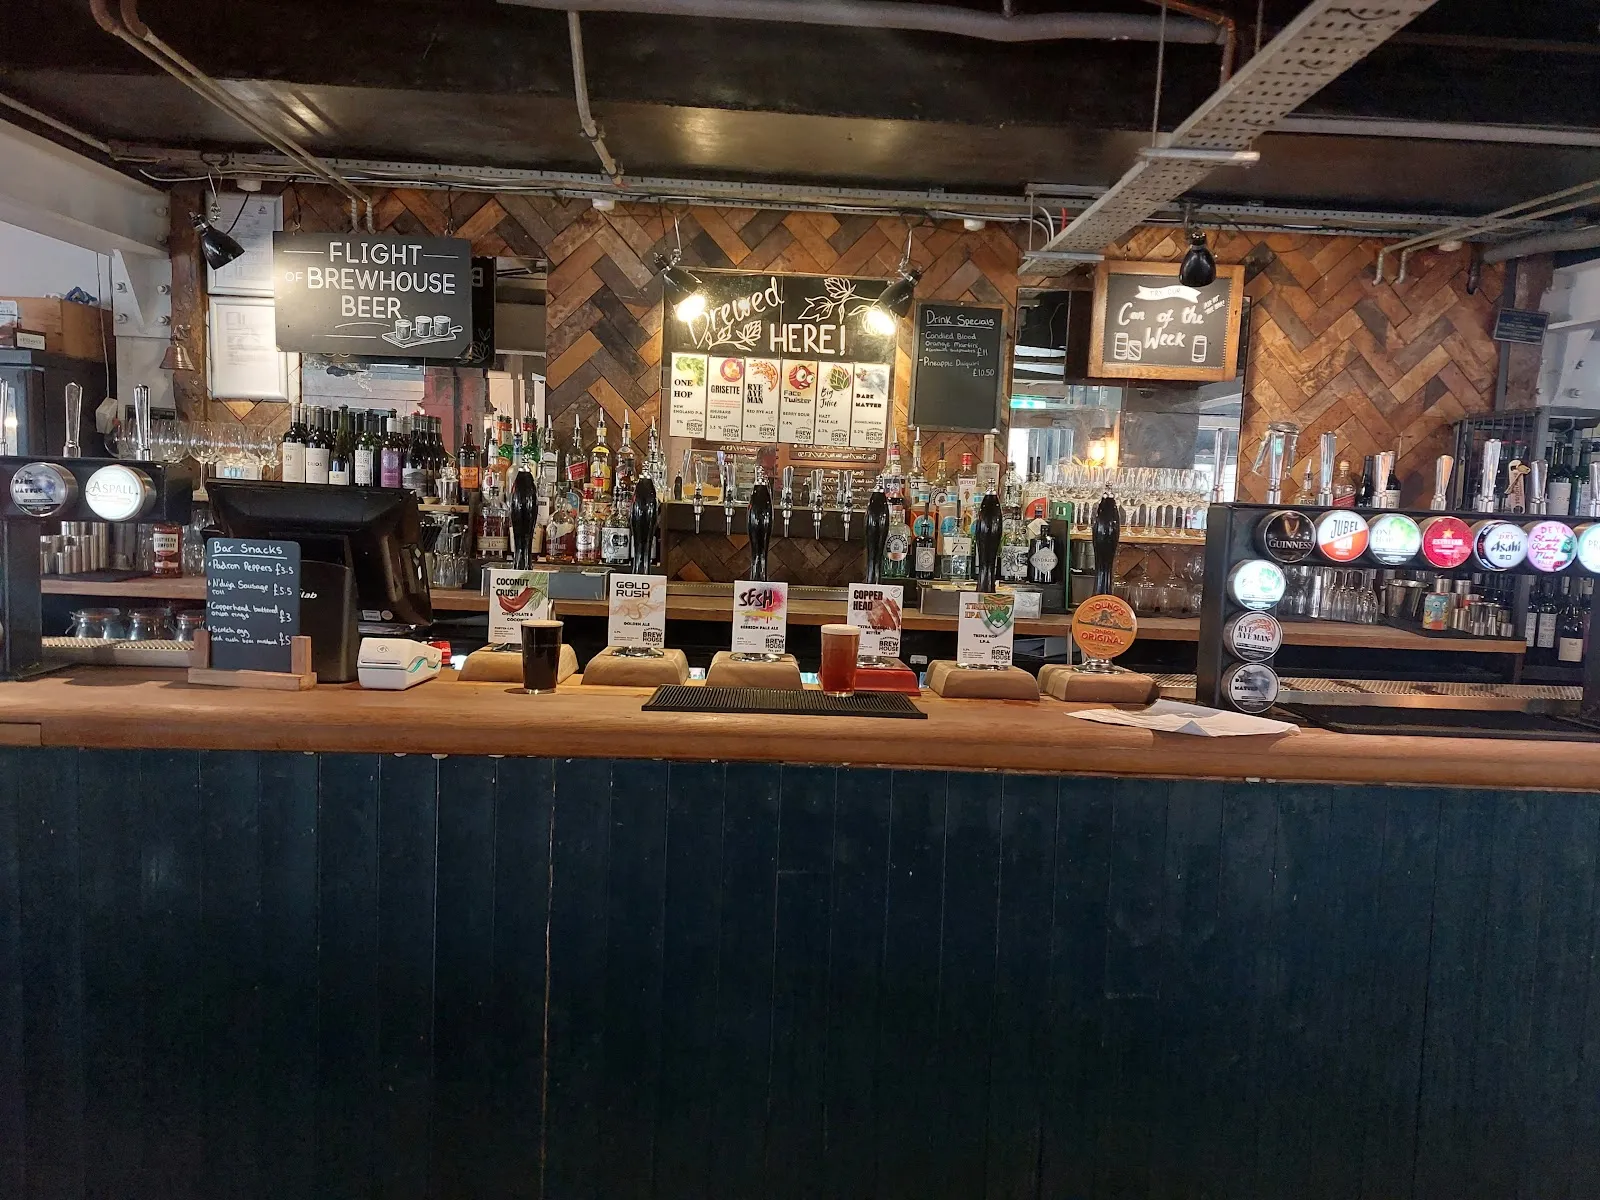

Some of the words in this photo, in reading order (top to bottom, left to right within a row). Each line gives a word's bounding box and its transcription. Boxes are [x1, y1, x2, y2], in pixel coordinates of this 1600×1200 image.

[329, 242, 422, 265] FLIGHT
[285, 271, 303, 282] OF
[307, 266, 456, 295] BREWHOUSE
[341, 295, 402, 319] BEER
[926, 310, 952, 325] Drink
[957, 314, 995, 327] Specials
[1118, 302, 1145, 326] Can
[1156, 308, 1174, 328] of
[1181, 305, 1204, 325] the
[769, 323, 846, 356] HERE!
[925, 331, 954, 340] Candied
[1144, 327, 1186, 349] Week
[925, 341, 951, 350] Orange
[977, 348, 988, 357] £11
[923, 356, 953, 367] Pineapple
[674, 379, 694, 387] ONE
[711, 385, 740, 394] GRISETTE
[747, 396, 763, 404] MAN
[819, 398, 837, 408] Juice
[88, 481, 134, 496] ASPALL
[1330, 519, 1358, 538] JUBEL
[1541, 526, 1567, 534] DEYA
[213, 541, 234, 553] Bar
[240, 543, 283, 555] Snacks
[1268, 538, 1313, 549] GUINNESS
[1490, 540, 1521, 552] Asahi
[212, 559, 240, 570] Padron
[244, 561, 273, 573] Peppers
[275, 563, 294, 576] £3.5
[496, 577, 529, 586] COCONUT
[616, 581, 650, 590] GOLD
[237, 580, 269, 593] Sausage
[273, 583, 293, 596] £5.5
[495, 589, 518, 597] CRUSH
[616, 590, 650, 598] RUSH
[738, 588, 773, 608] SESH
[853, 589, 883, 600] COPPER
[853, 600, 873, 610] HEAD
[1089, 602, 1126, 616] YOUNG'S
[231, 612, 250, 620] rings
[279, 609, 292, 623] £3
[212, 626, 235, 634] Scotch
[236, 628, 250, 639] egg
[279, 631, 291, 646] £5
[1081, 632, 1124, 646] ORIGINAL
